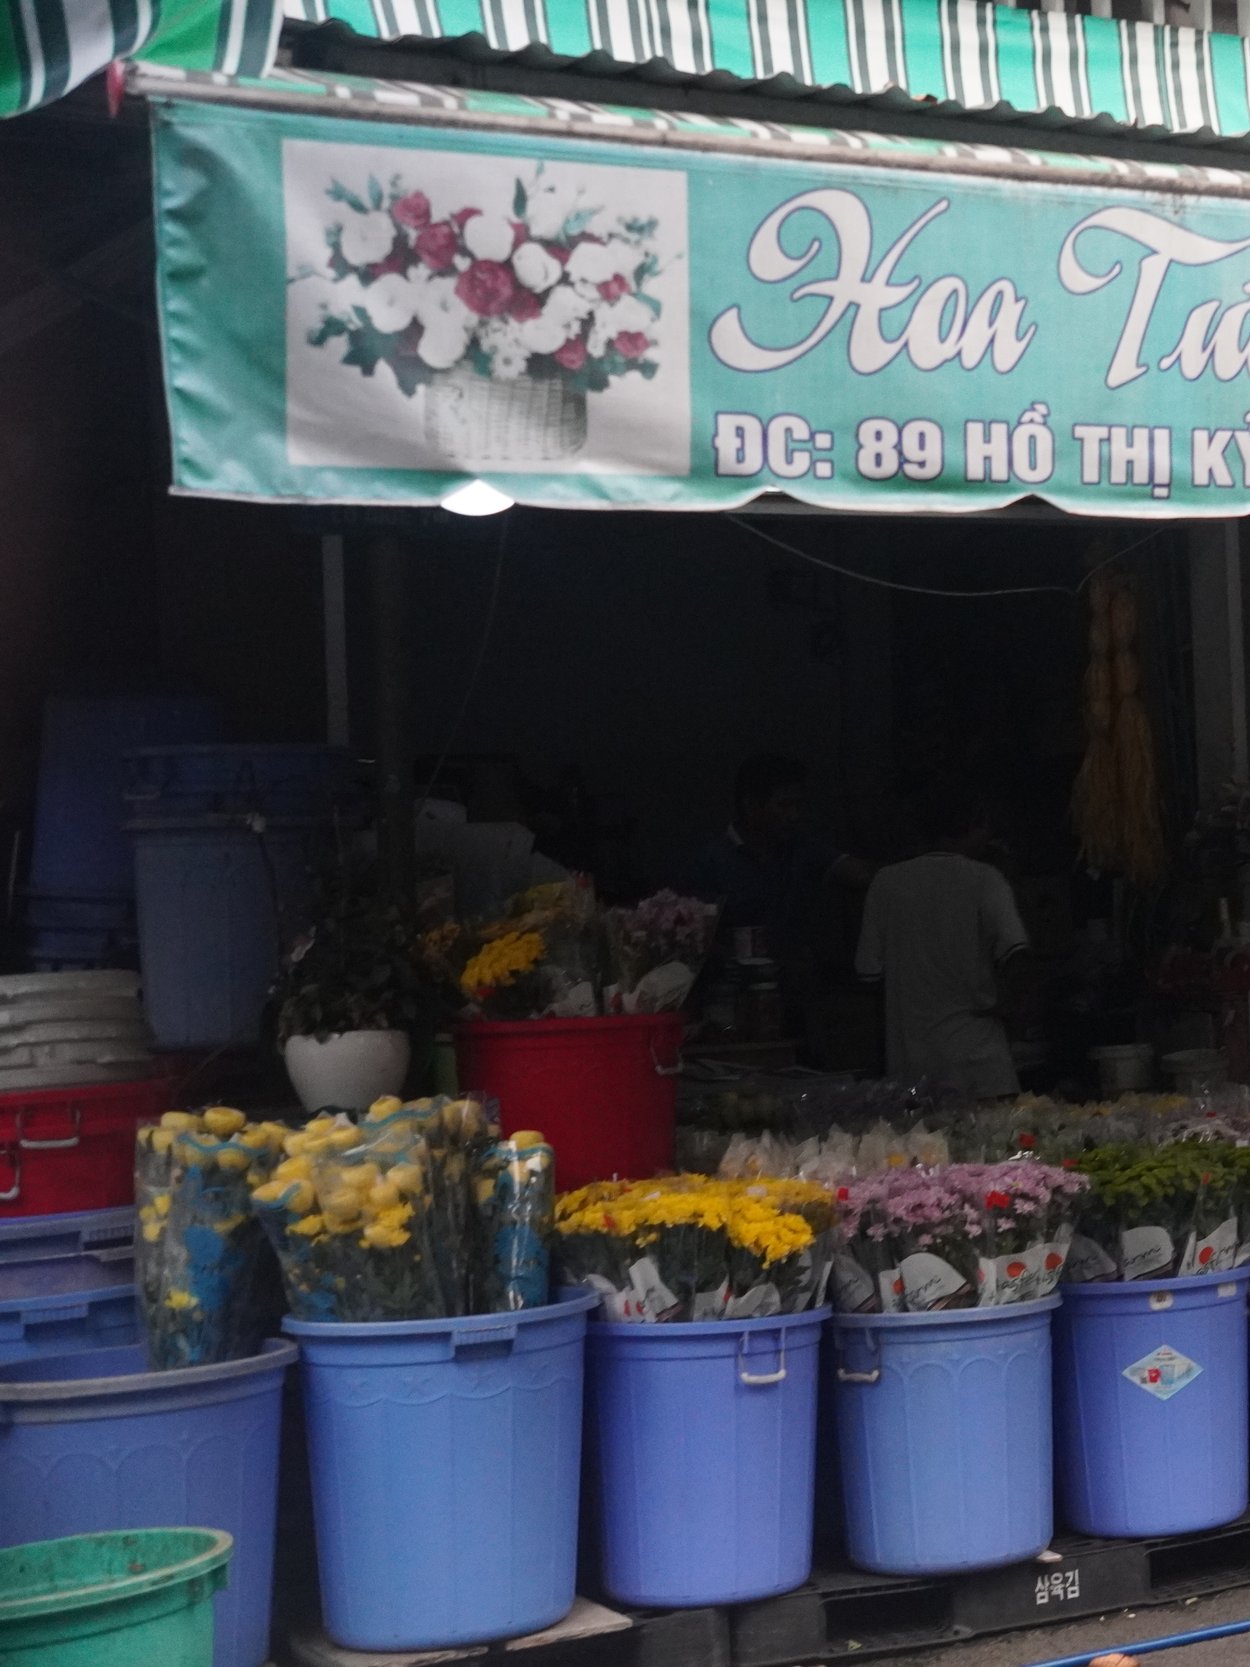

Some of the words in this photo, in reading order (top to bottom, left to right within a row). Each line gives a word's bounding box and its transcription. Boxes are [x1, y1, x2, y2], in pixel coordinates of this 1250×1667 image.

[707, 188, 1038, 375] Hoa
[713, 412, 834, 480] ĐC:
[856, 416, 943, 482] 89
[965, 402, 1055, 484] HỒ
[1073, 423, 1172, 499] THỊ
[1034, 1568, 1080, 1605] 삼육김
